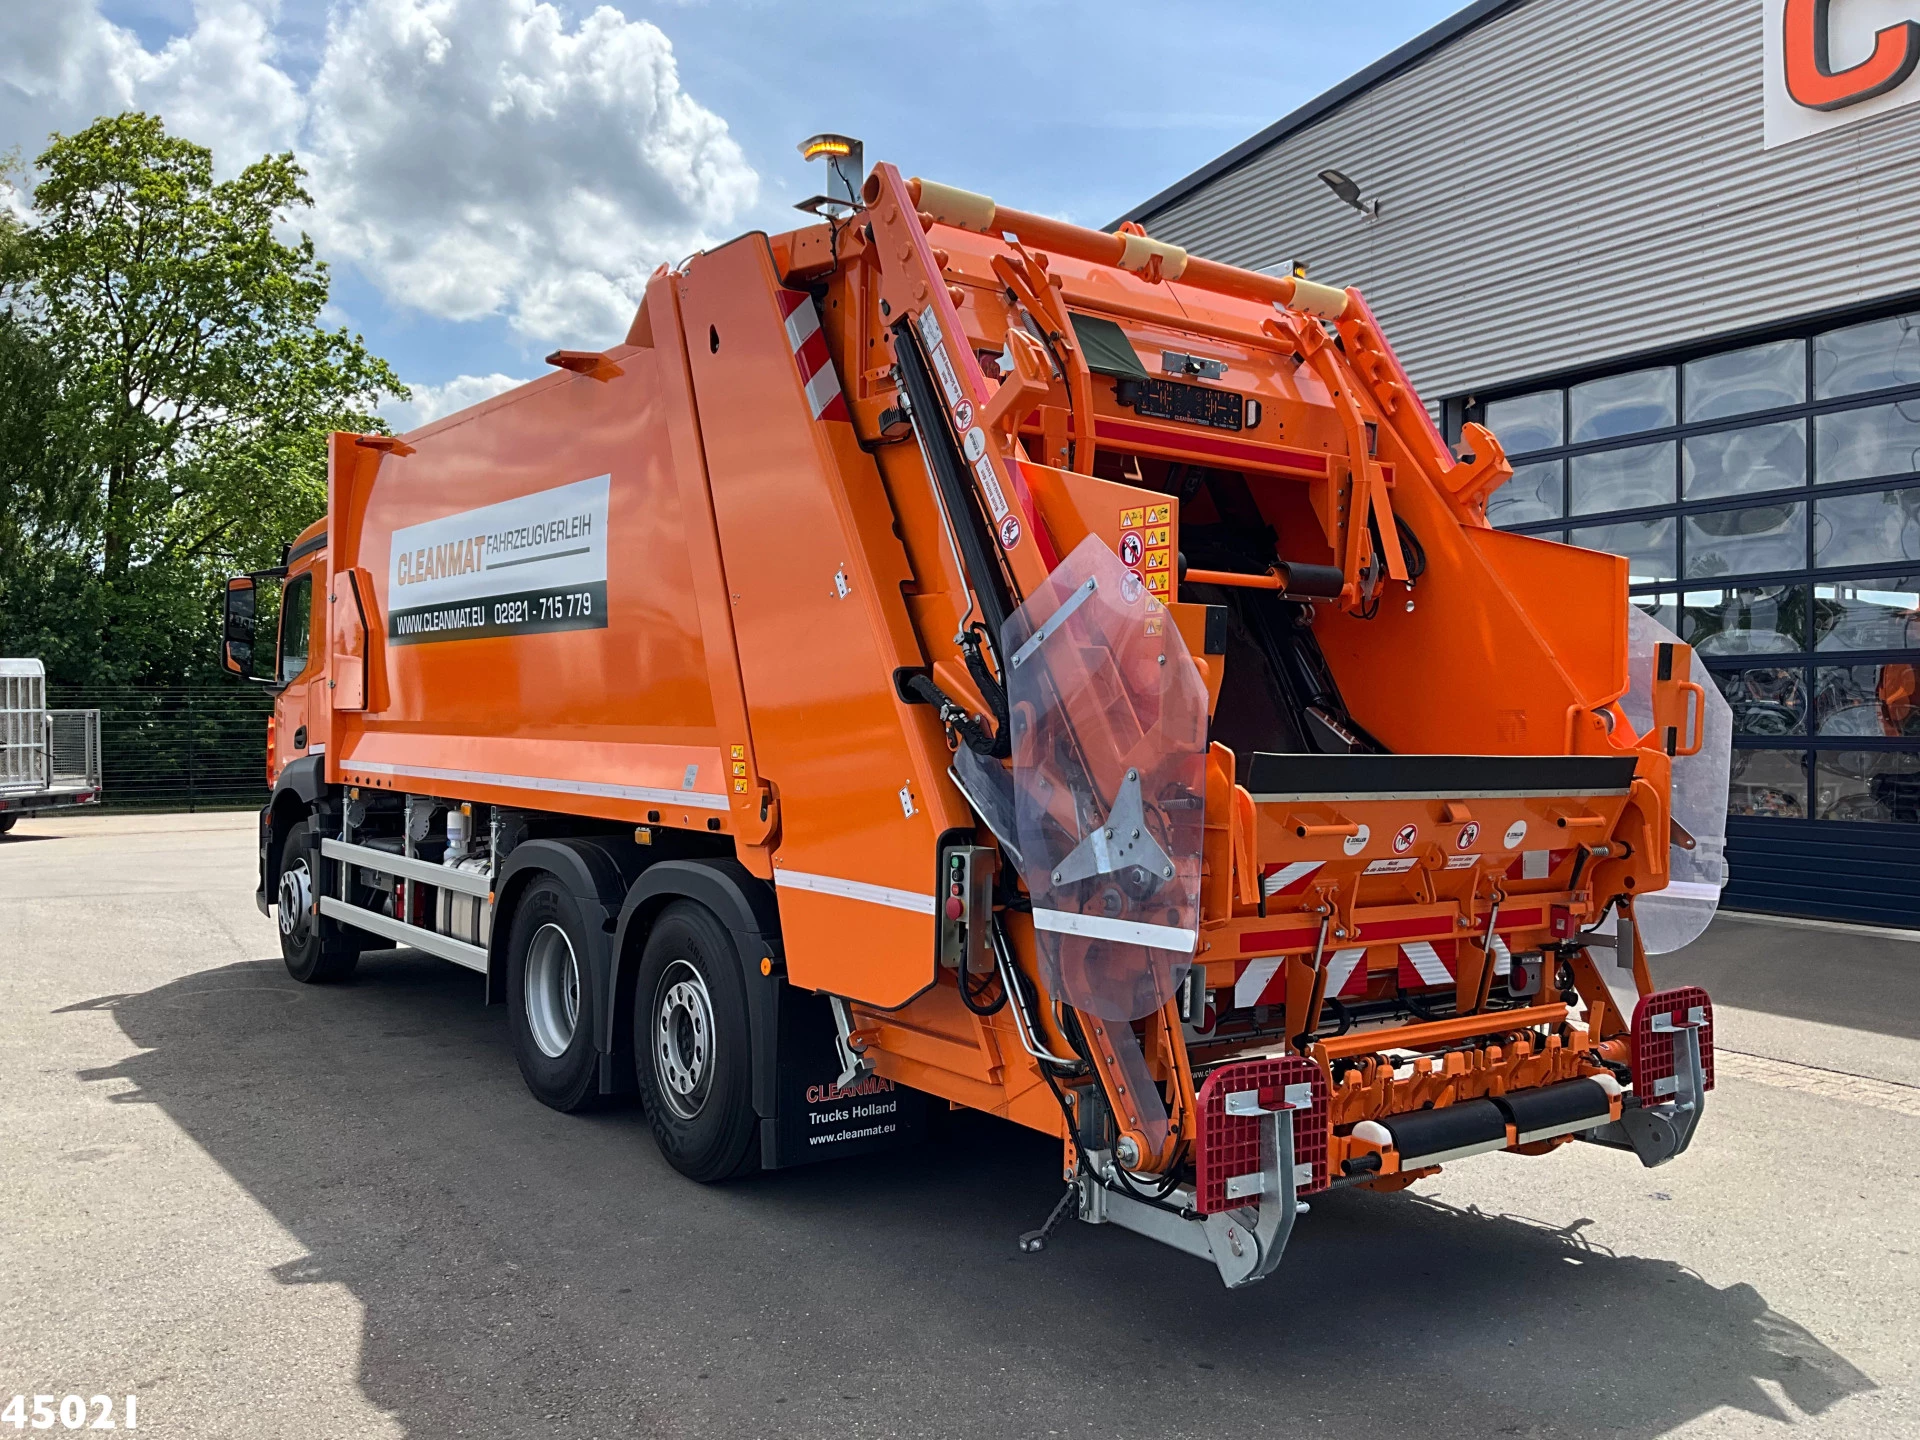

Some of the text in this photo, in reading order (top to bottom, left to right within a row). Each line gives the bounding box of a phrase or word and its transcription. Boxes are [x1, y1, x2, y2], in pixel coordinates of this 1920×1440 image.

[397, 513, 592, 587] CLEANMAT FAHRZEUGVERLEIH
[397, 605, 485, 635] WWW.CLEANMAT.EU
[494, 600, 529, 625] 02821
[539, 596, 563, 621] 715
[566, 592, 592, 617] 779
[809, 1101, 897, 1125] Trucks Holland
[809, 1124, 896, 1146] www.cleanmat.eu
